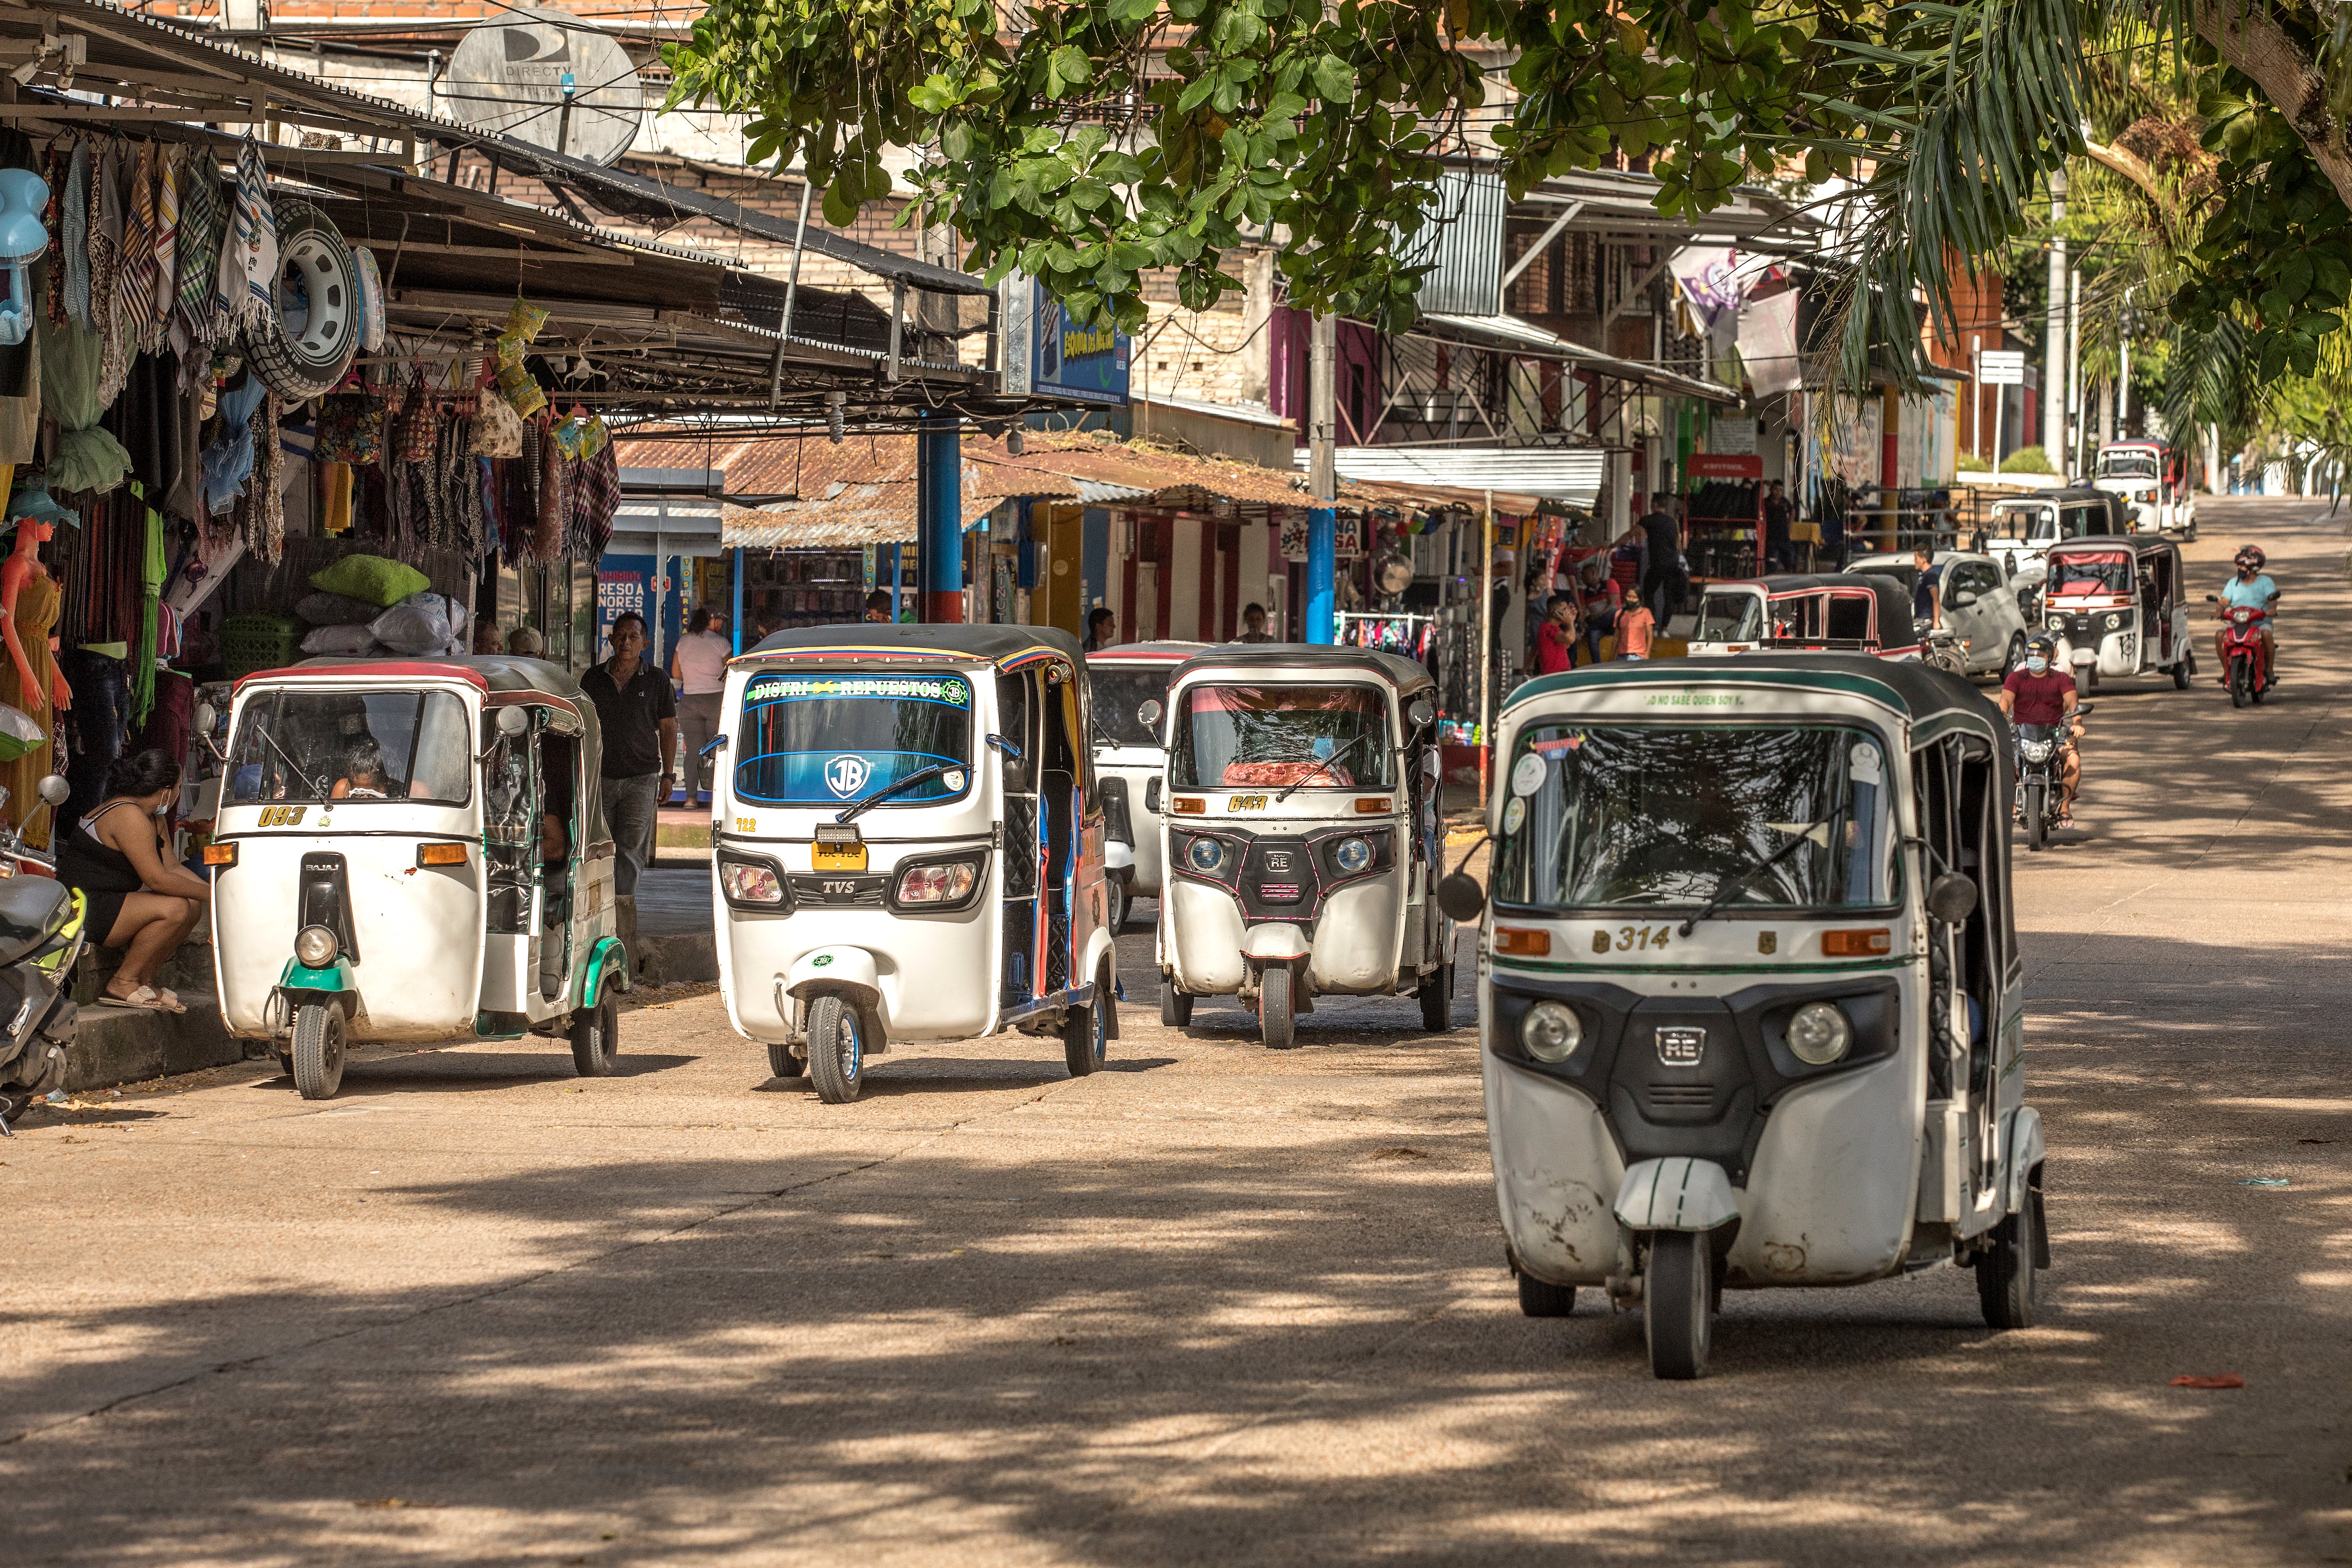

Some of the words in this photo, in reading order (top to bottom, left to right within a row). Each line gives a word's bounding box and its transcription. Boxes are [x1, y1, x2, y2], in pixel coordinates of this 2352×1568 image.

[507, 66, 571, 76] DIRECTV
[636, 583, 644, 595] A
[754, 681, 810, 700] DISTRI
[840, 680, 940, 698] REPUESTOS
[830, 759, 863, 791] JB
[1228, 796, 1268, 812] 643
[258, 806, 307, 827] 093
[736, 818, 756, 832] 722
[1271, 857, 1287, 868] RE
[823, 881, 855, 893] TVS
[1616, 925, 1670, 951] 314
